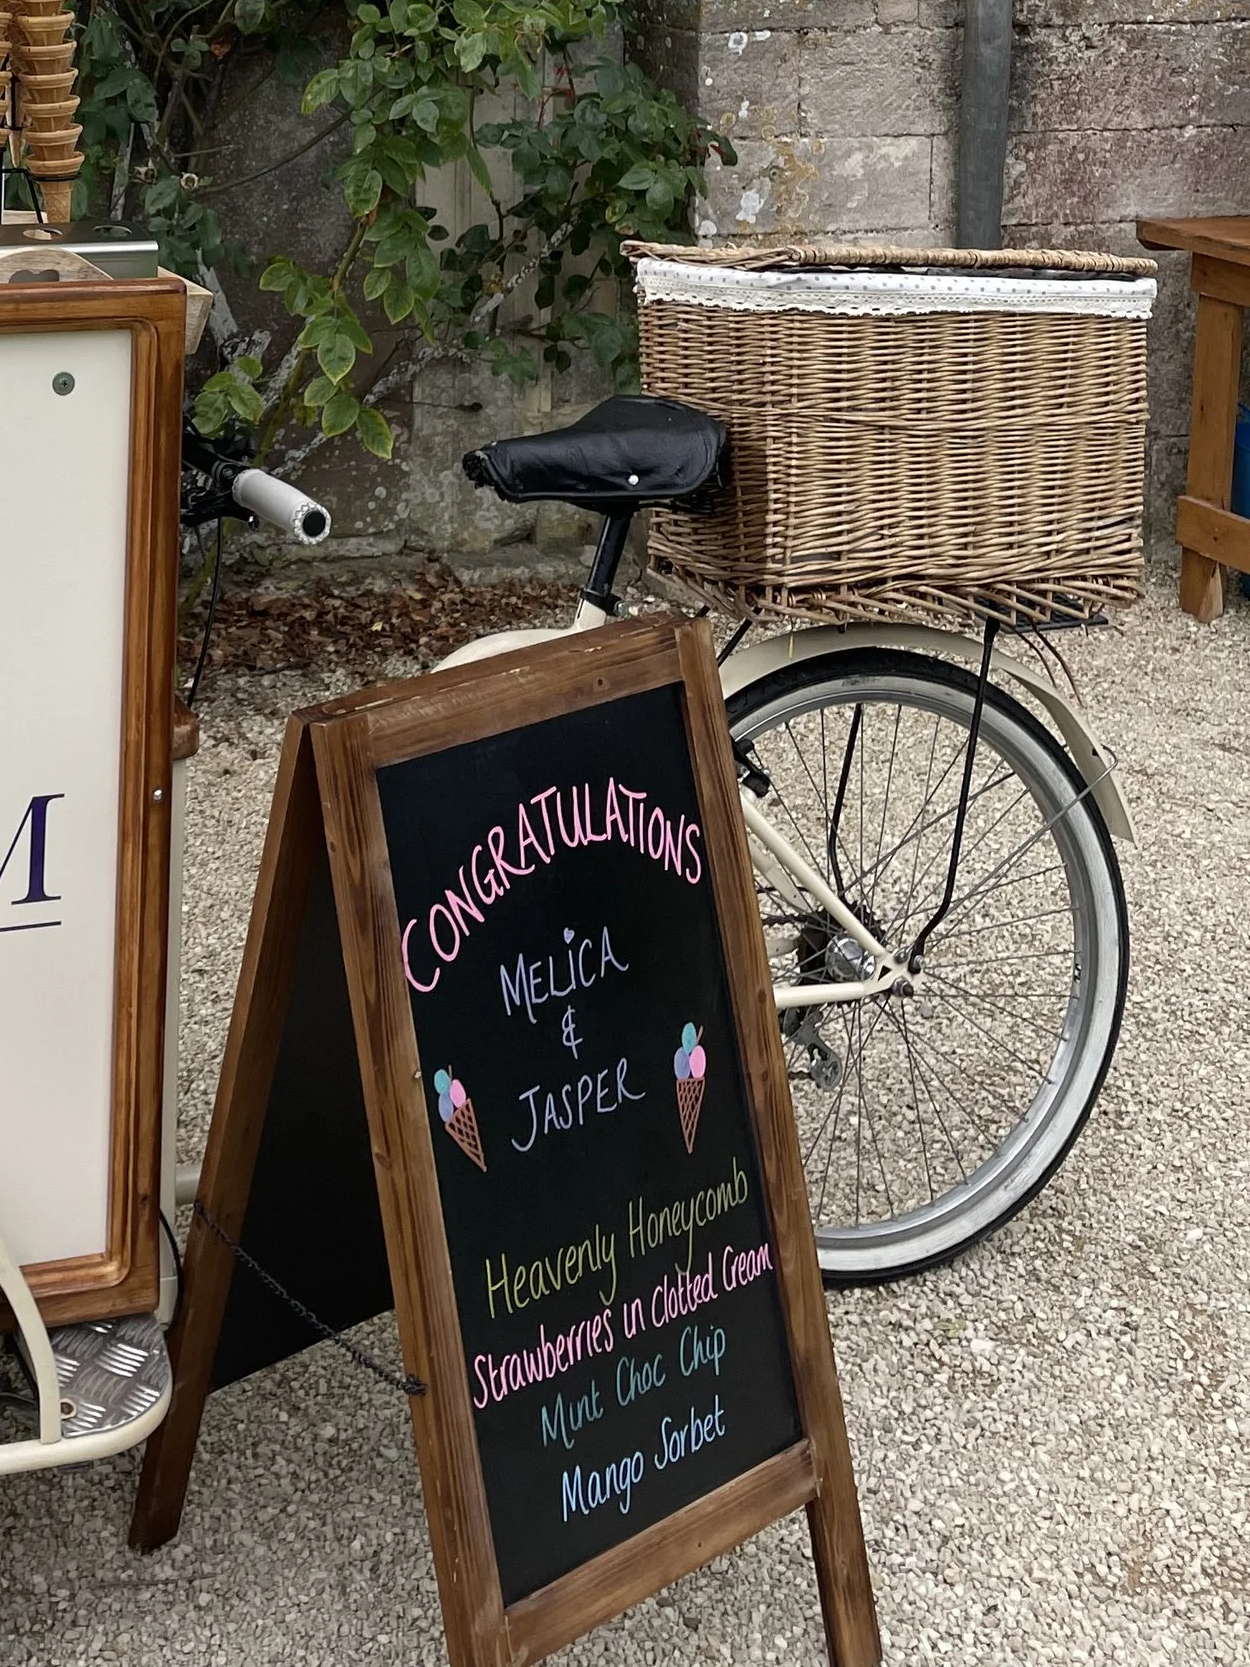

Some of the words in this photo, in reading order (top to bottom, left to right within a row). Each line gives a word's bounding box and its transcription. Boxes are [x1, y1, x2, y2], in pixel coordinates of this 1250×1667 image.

[400, 776, 702, 993] CONGRATULATIONS
[511, 1057, 646, 1152] JASPER
[485, 1224, 616, 1319] Heavenly
[628, 1156, 749, 1275] Honeycomb
[473, 1308, 614, 1409] Strawberries
[722, 1242, 774, 1292] Cream
[541, 1379, 604, 1449] Mint
[616, 1353, 666, 1407] Choc
[679, 1325, 726, 1376] Chip
[561, 1451, 644, 1523] Mango
[654, 1394, 726, 1470] Sorbet
